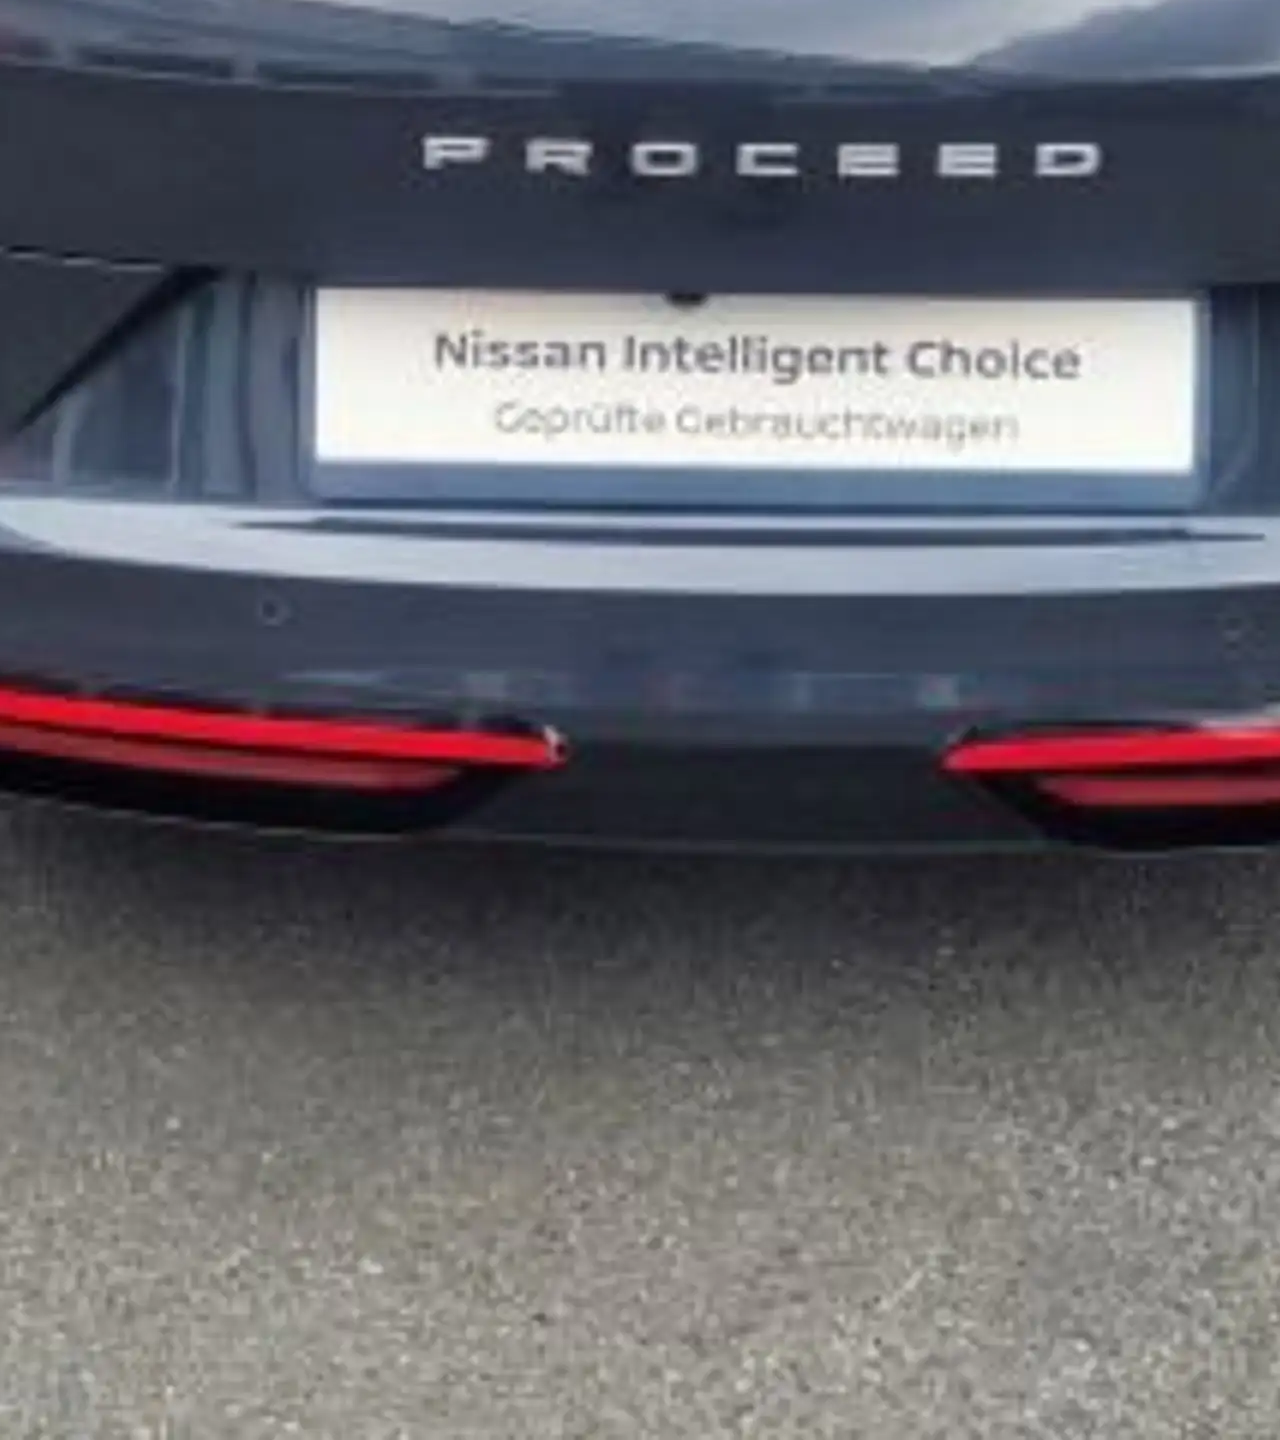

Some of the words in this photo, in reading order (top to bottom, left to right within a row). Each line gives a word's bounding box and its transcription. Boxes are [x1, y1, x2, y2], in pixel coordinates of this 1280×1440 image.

[421, 135, 1104, 180] PROCEED
[433, 330, 607, 371] Nissan
[622, 335, 892, 386] Intelligent
[906, 338, 1083, 380] Choice
[493, 400, 667, 442] Geprüfte
[675, 405, 1020, 455] Gebrauchtwagen
